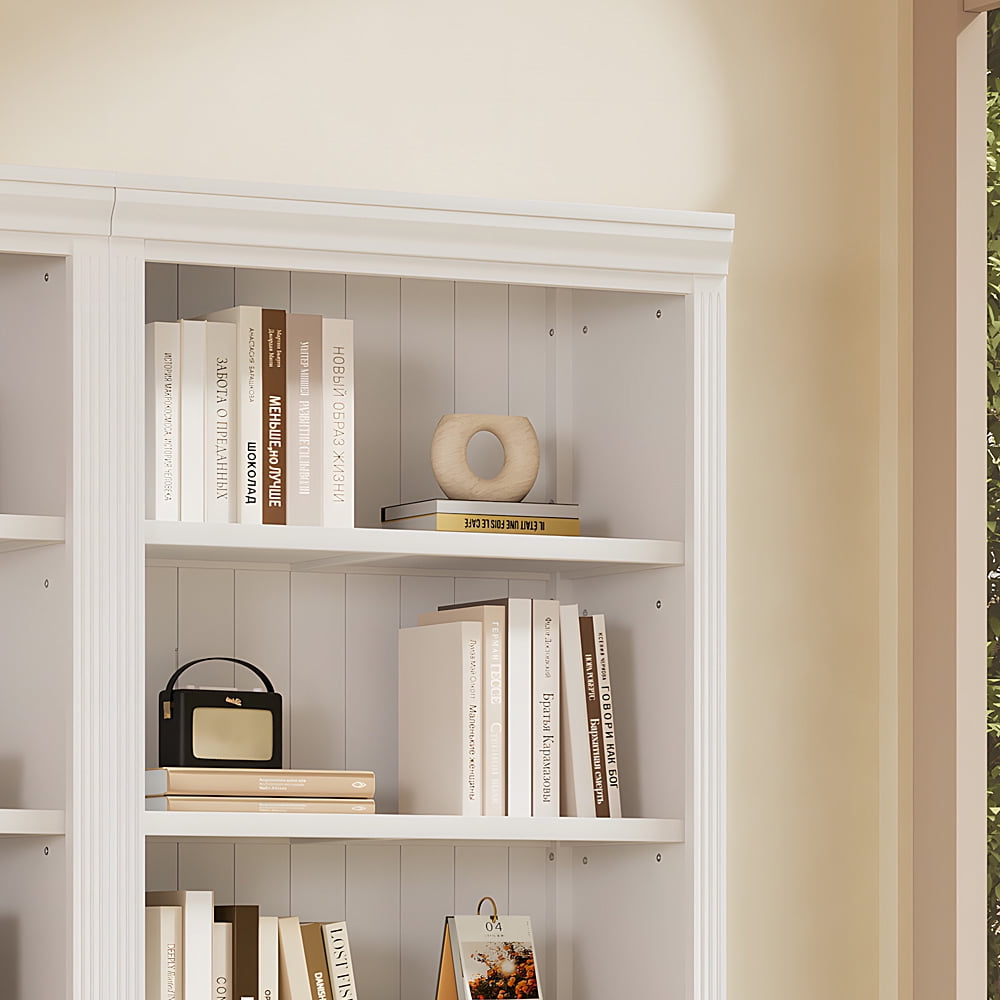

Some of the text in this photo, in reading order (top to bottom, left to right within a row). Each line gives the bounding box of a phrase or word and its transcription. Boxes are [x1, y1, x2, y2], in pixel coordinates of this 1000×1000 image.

[216, 357, 228, 499] ЗАБОТА О ПРЕДАННЫХ
[333, 346, 347, 503] НОВЫЙ ОБРАЗ ЖИЗНИ
[245, 442, 256, 504] ШОКОЛАД
[482, 519, 490, 528] LE
[491, 519, 505, 529] FOIS
[506, 520, 519, 530] UNE
[539, 521, 544, 531] IL
[490, 663, 502, 705] ГЕССЕ
[539, 693, 554, 731] Братья
[601, 685, 619, 789] ГОВОРИ КАК БОГ
[539, 735, 554, 803] Карамазовы
[485, 921, 502, 932] 04
[330, 928, 349, 967] LOST
